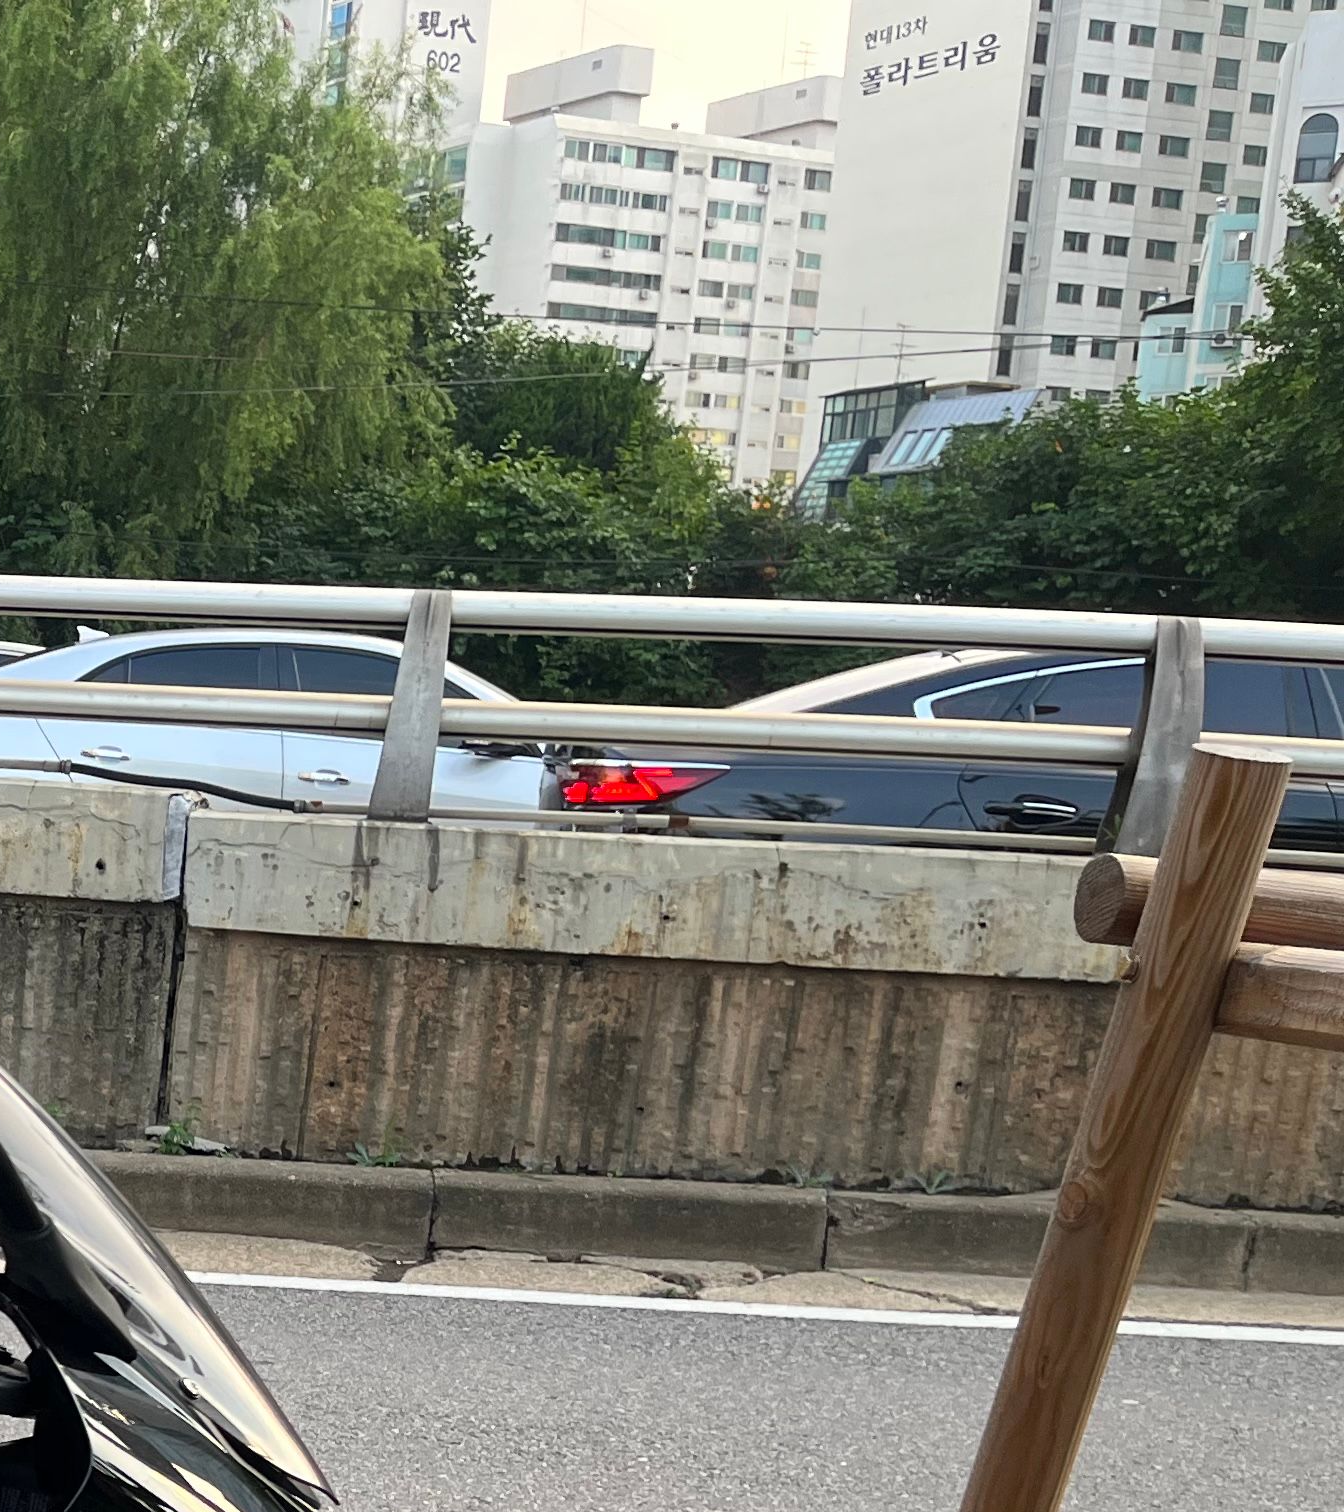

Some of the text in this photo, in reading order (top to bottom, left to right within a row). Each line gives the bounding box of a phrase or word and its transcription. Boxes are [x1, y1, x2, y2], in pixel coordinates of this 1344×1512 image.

[418, 11, 476, 43] 現代
[427, 50, 461, 73] 602
[860, 33, 1001, 96] 폴라트리움
